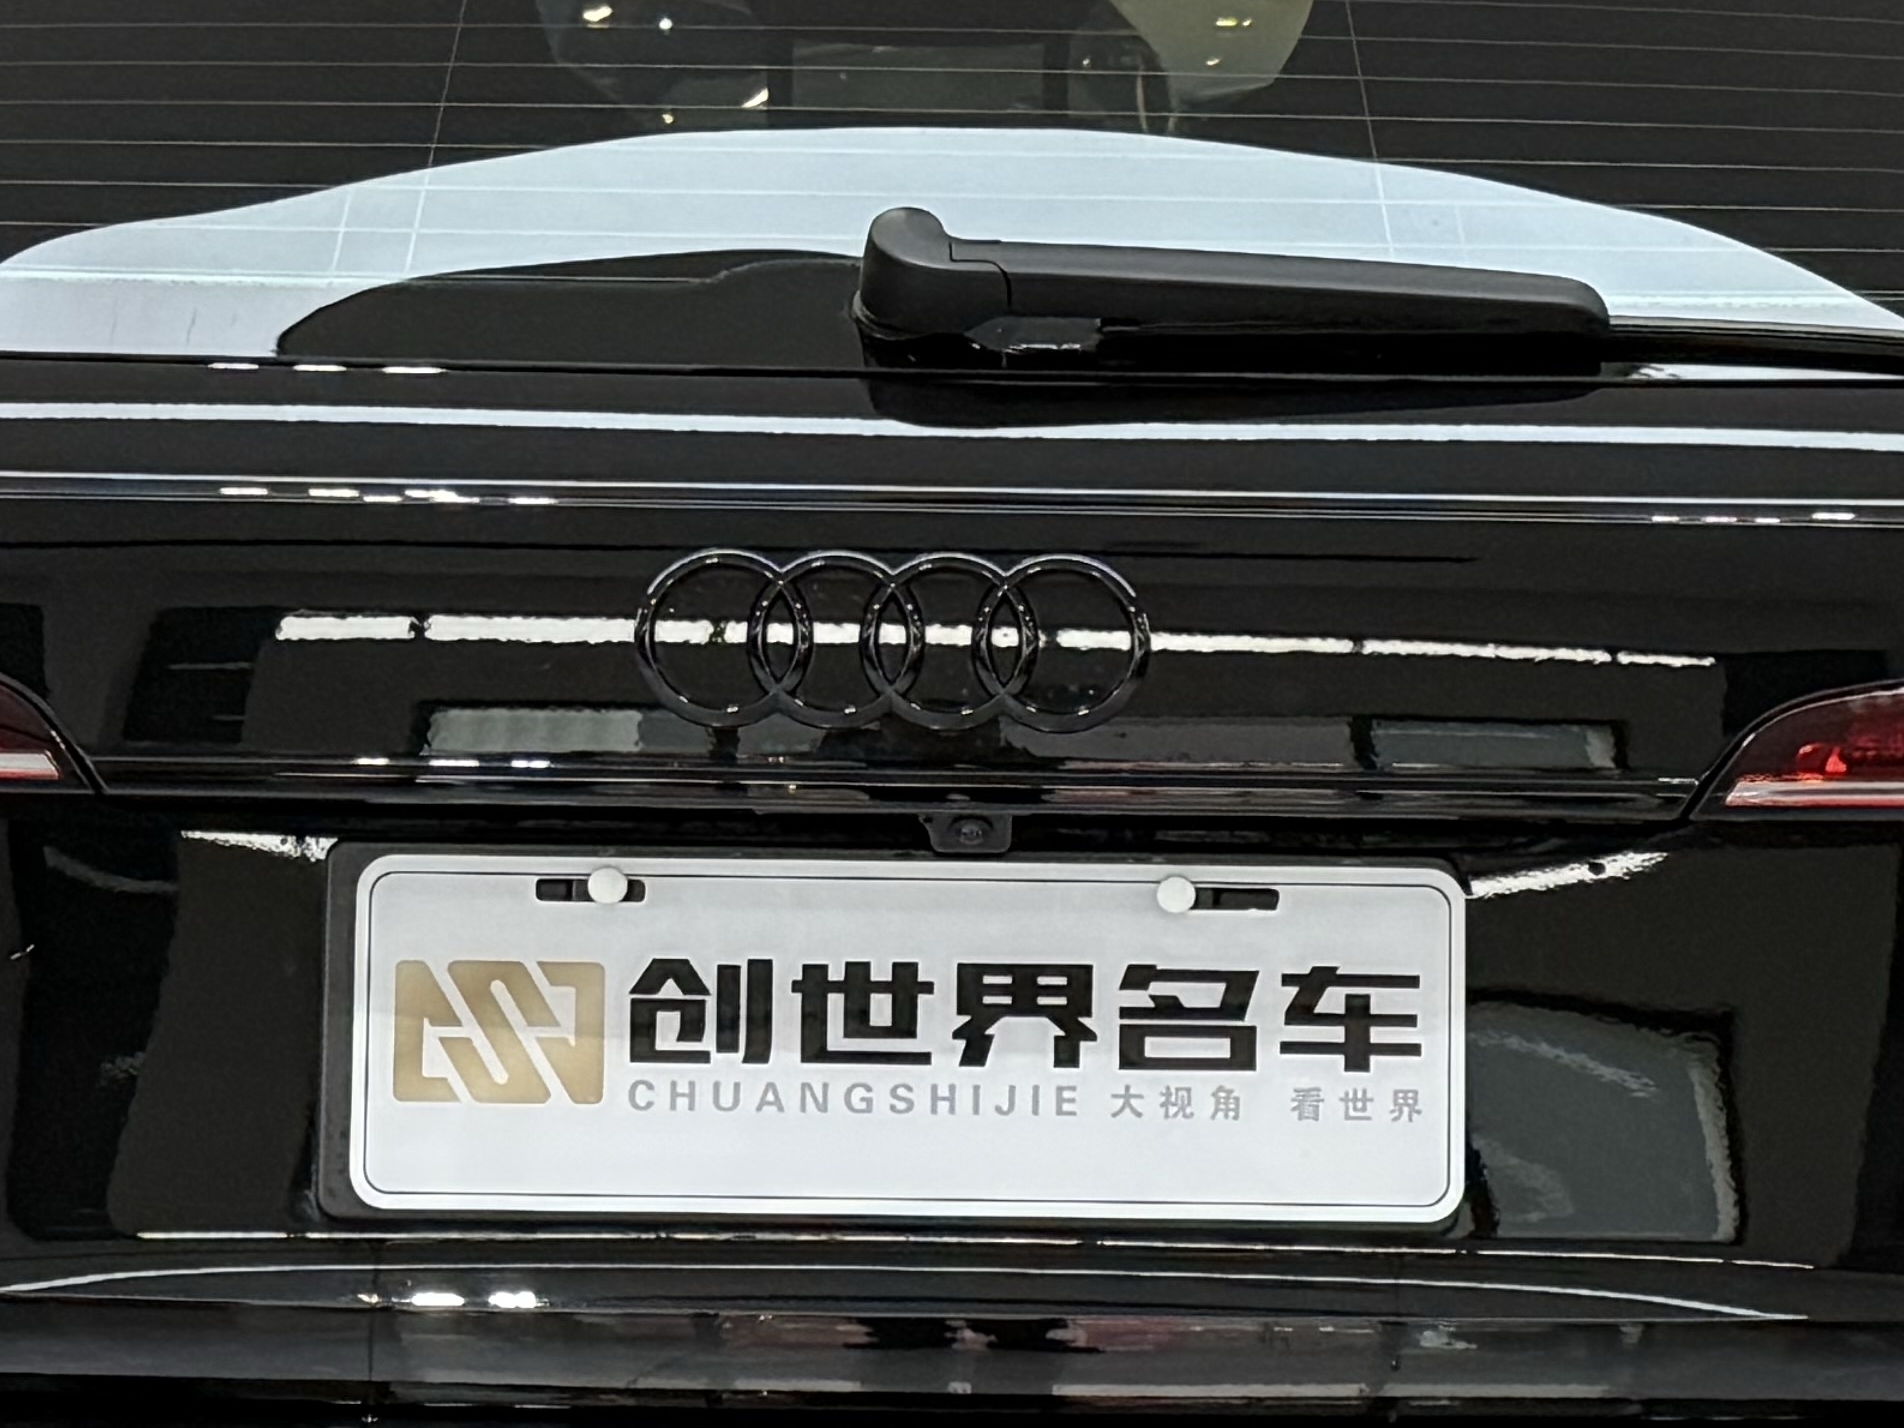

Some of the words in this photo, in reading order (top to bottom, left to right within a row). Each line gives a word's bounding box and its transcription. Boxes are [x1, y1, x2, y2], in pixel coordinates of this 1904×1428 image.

[628, 958, 1422, 1072] 创世界名车
[628, 1080, 1078, 1117] CHUANGSHIJIE
[1109, 1084, 1242, 1121] 大视角
[1290, 1086, 1423, 1123] 看世界
